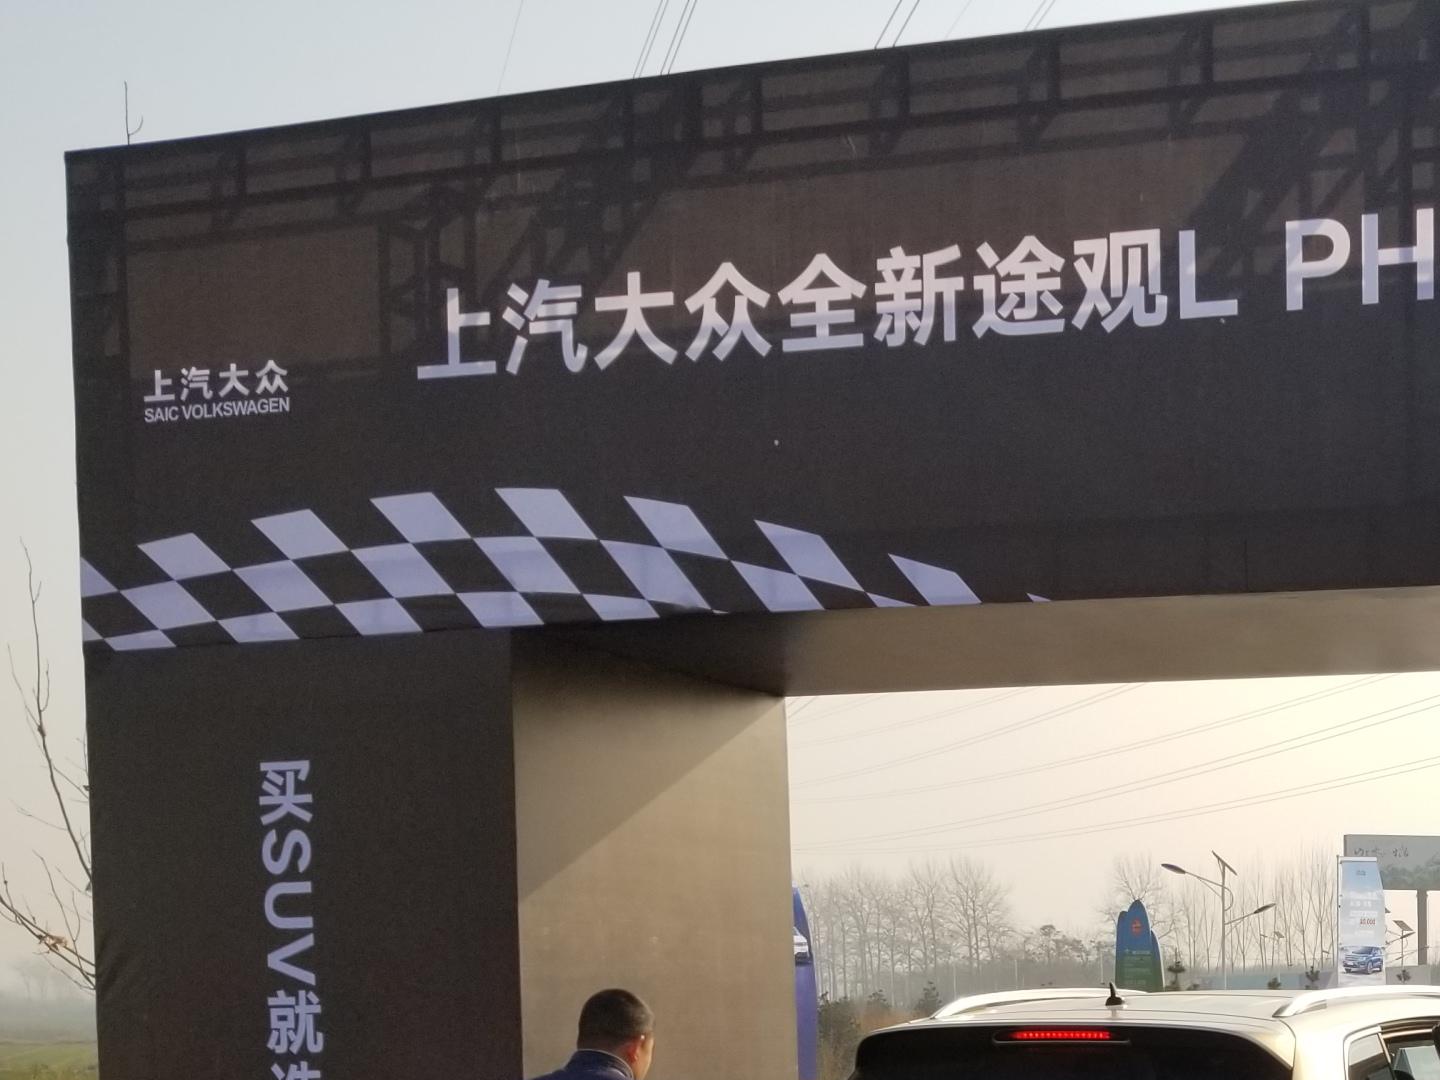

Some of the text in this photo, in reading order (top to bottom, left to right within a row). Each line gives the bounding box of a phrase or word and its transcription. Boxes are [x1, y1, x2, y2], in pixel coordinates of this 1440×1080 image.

[417, 228, 1239, 380] 上汽大众全新途观L
[143, 359, 289, 402] 上汽大众
[144, 396, 291, 424] SAIC VOLKSWAGEN
